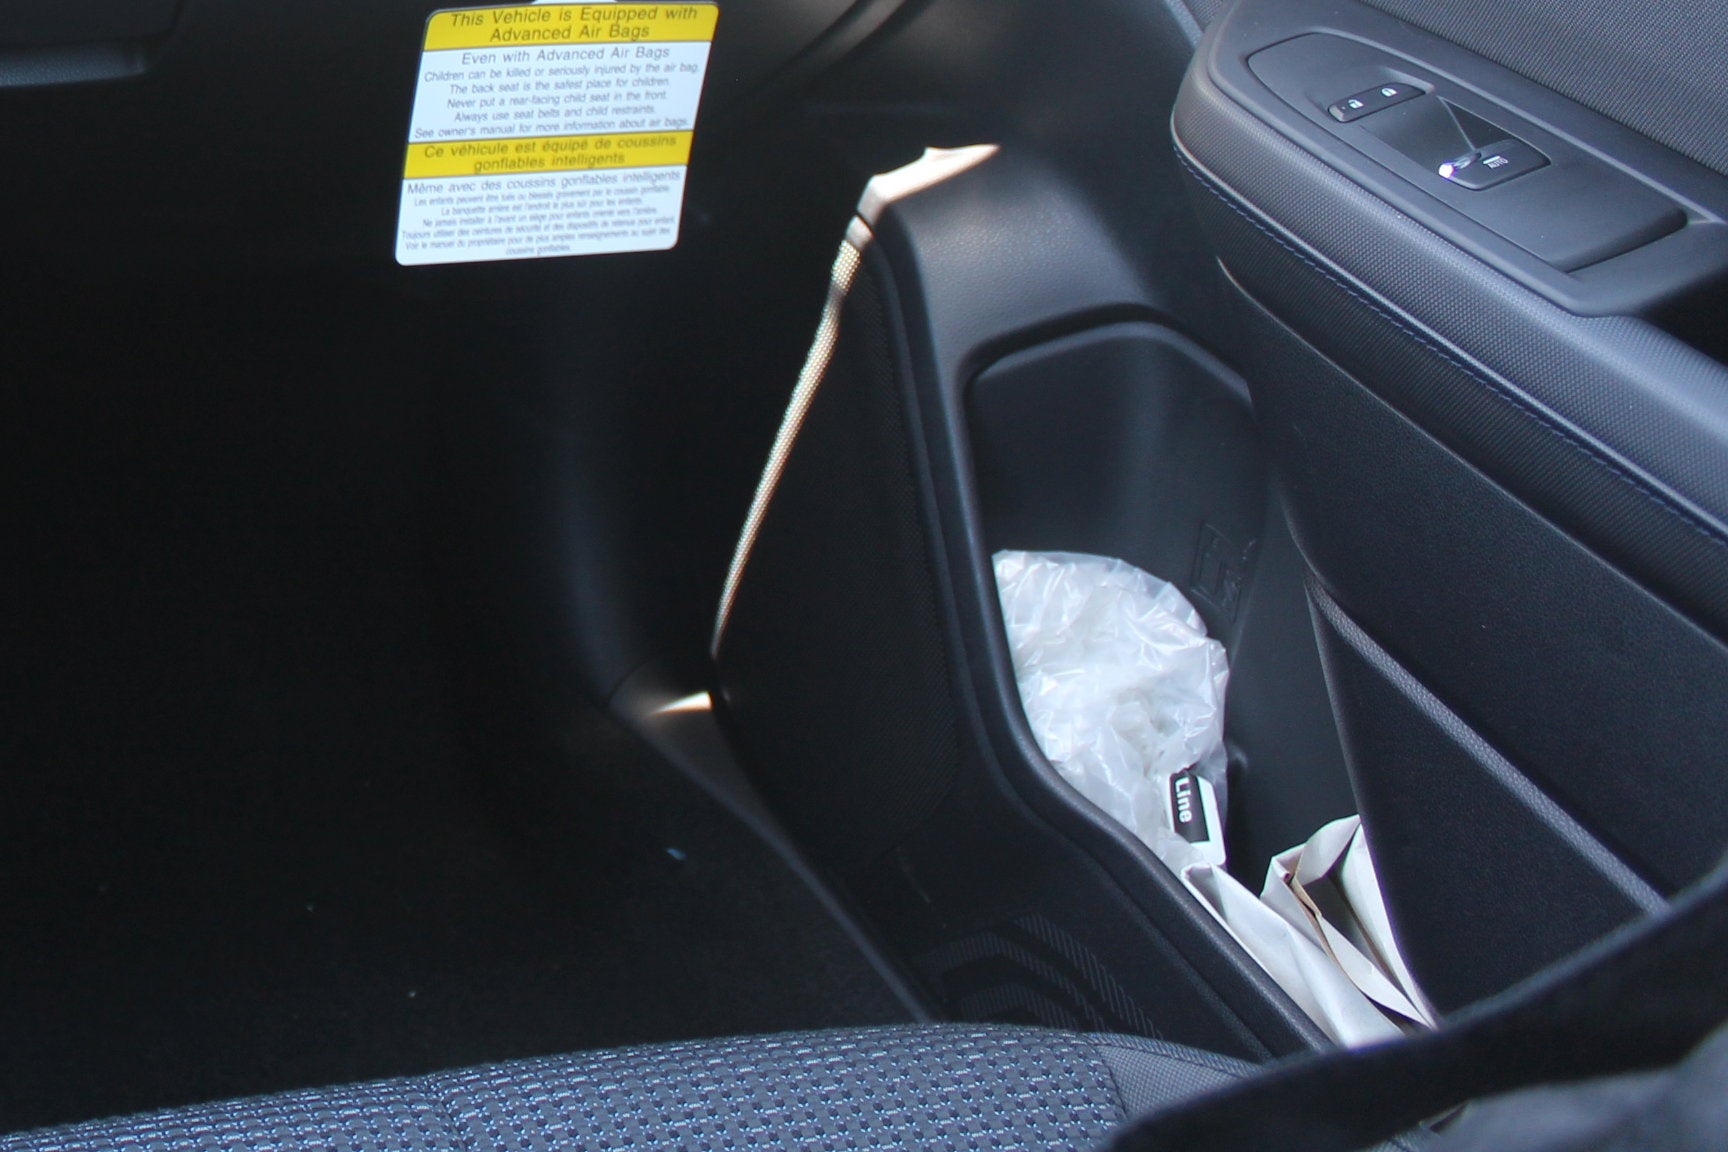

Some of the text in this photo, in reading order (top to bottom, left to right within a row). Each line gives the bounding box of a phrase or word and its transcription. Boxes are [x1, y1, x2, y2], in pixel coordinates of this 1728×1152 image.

[452, 6, 698, 26] This Vehicle is Equipped with
[490, 25, 650, 42] Advanced Air Bags
[460, 46, 670, 65] Even with Advanced Air Bags
[1174, 777, 1193, 824] Line
